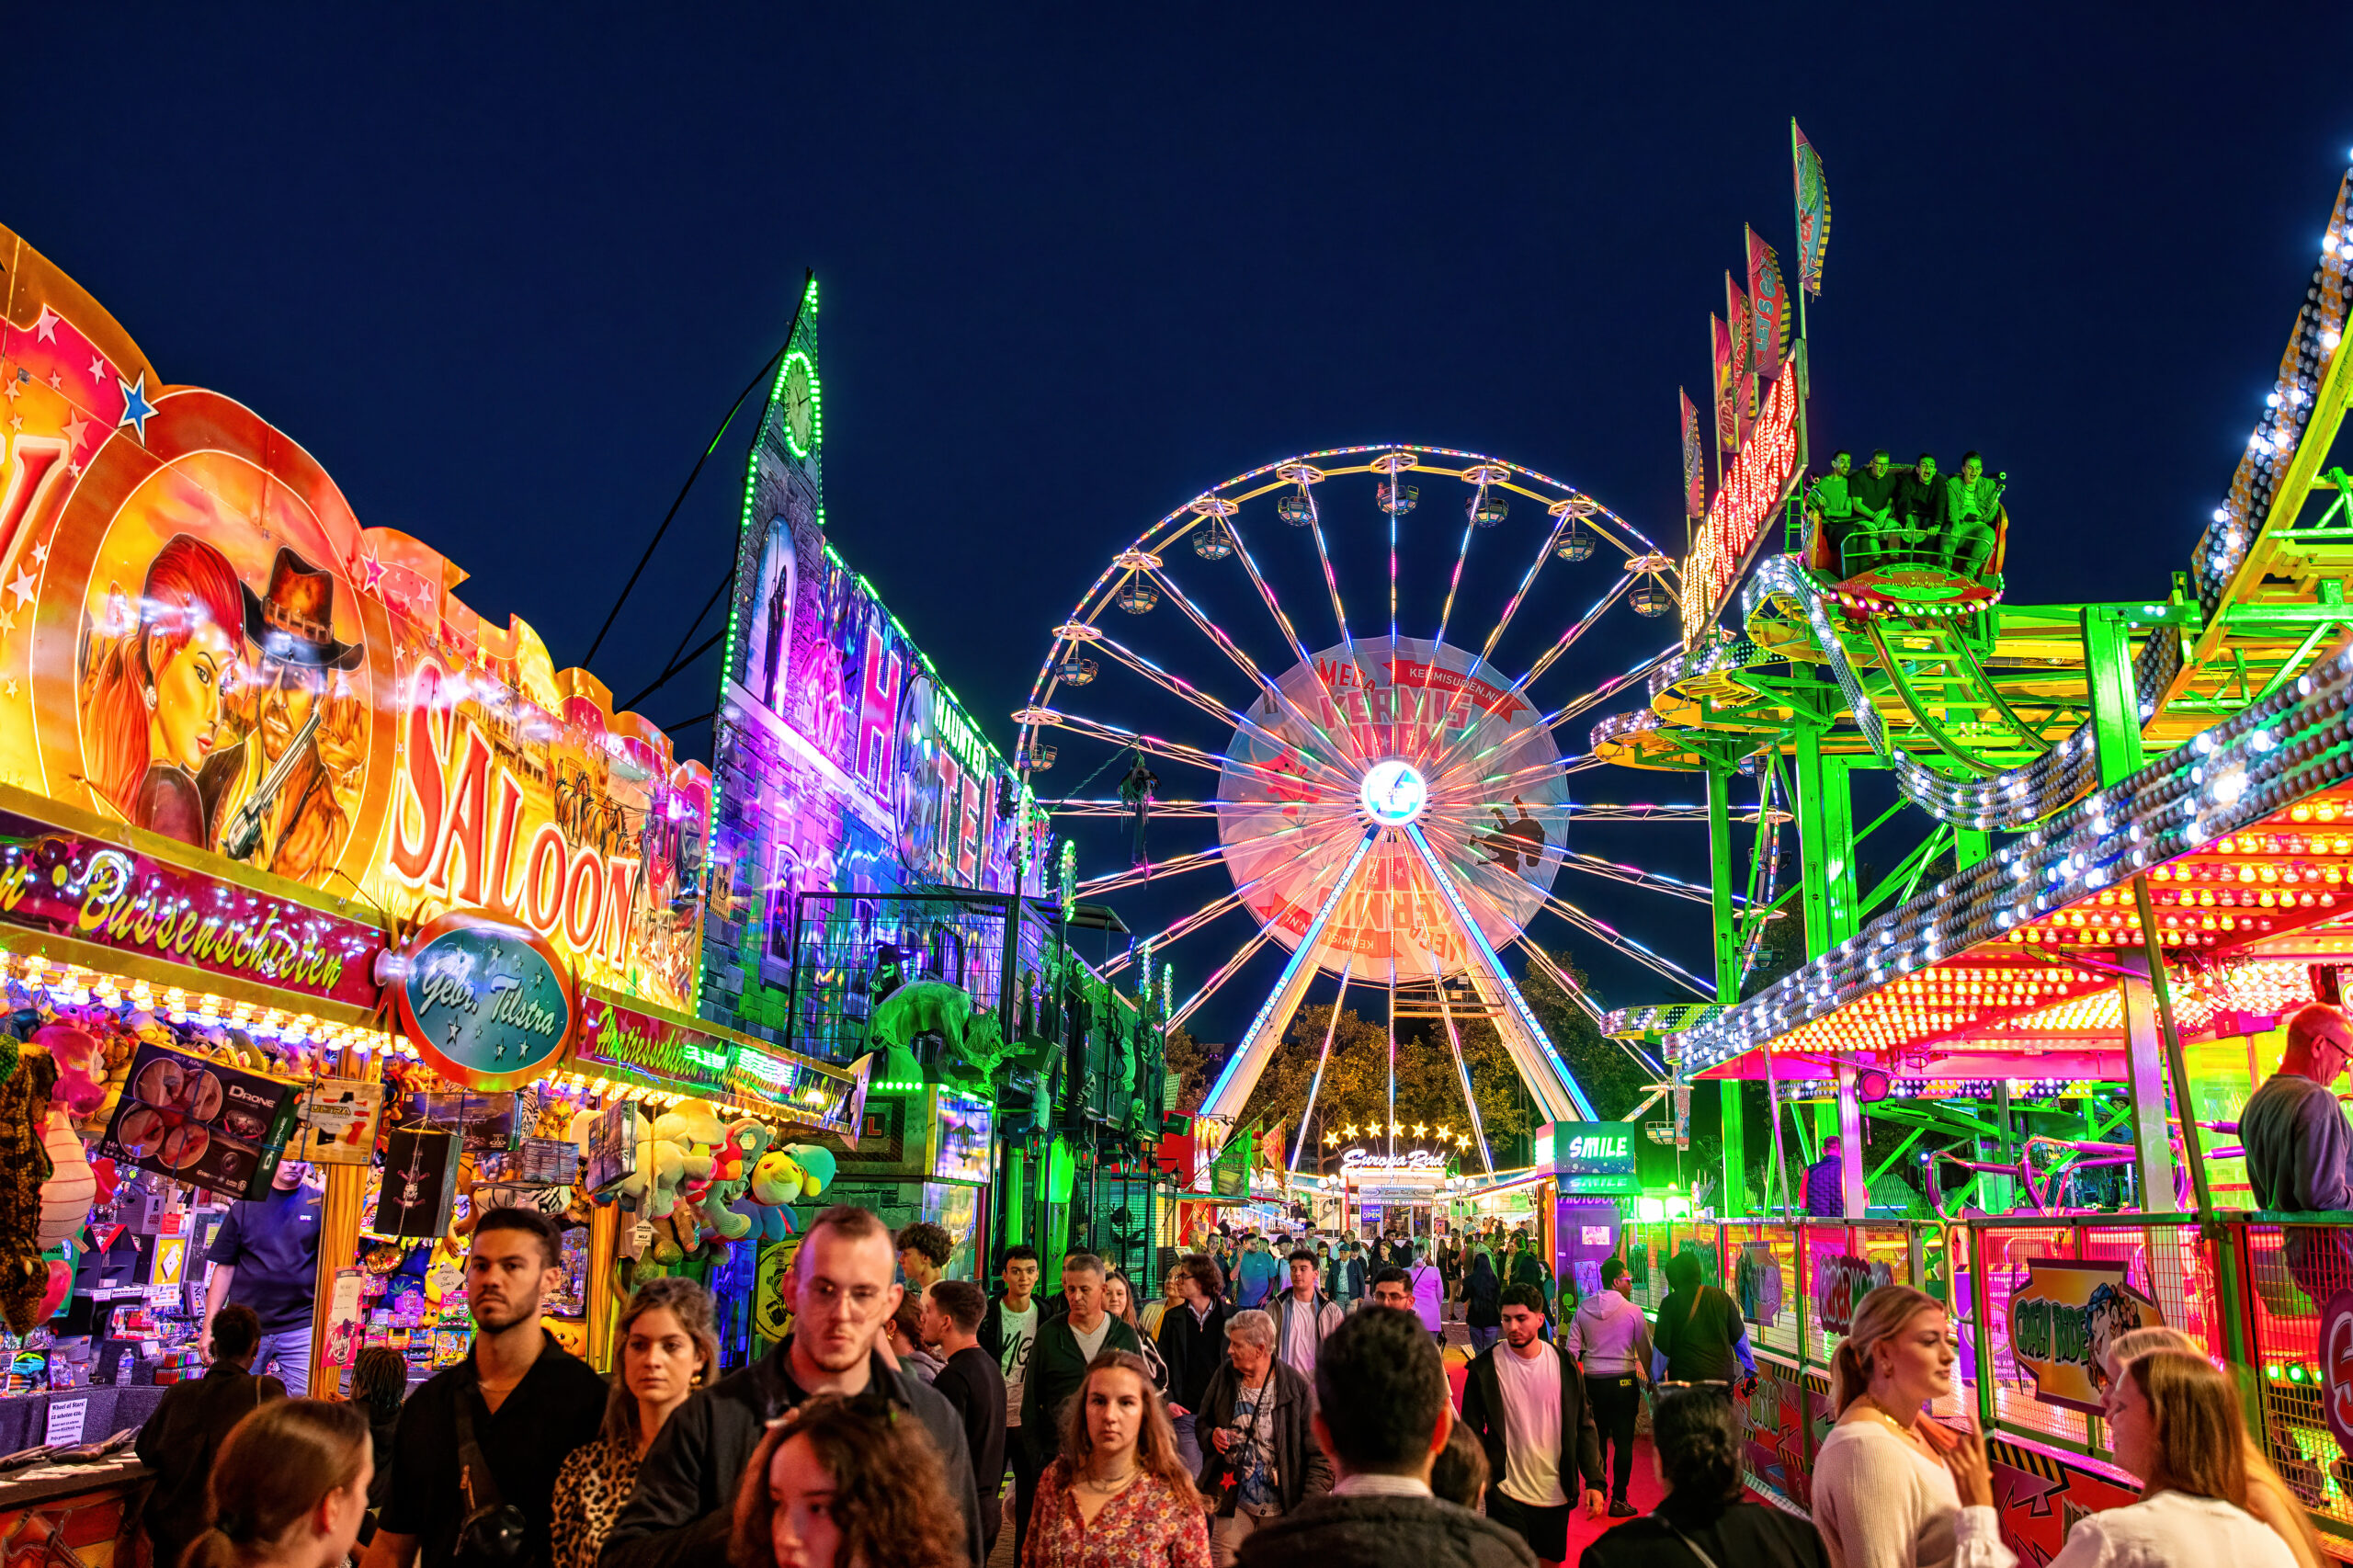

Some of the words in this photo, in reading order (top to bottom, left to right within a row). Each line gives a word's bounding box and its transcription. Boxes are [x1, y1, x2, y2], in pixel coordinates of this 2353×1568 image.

[1319, 657, 1376, 694] MEGA
[1409, 667, 1500, 704] KERMISUDEN.NL
[1316, 685, 1473, 730] KERMIS
[934, 690, 987, 781] HAUNTED
[387, 655, 641, 969] SALOON
[78, 855, 344, 990] Bussenschieten
[420, 956, 479, 1016] Gebr.
[490, 973, 556, 1037] Tilstra
[311, 1105, 351, 1116] ULTRA
[1341, 1148, 1406, 1172] Europa
[1408, 1149, 1446, 1169] Rad
[1569, 1136, 1628, 1159] SMILE
[2013, 1297, 2051, 1362] CRAZY
